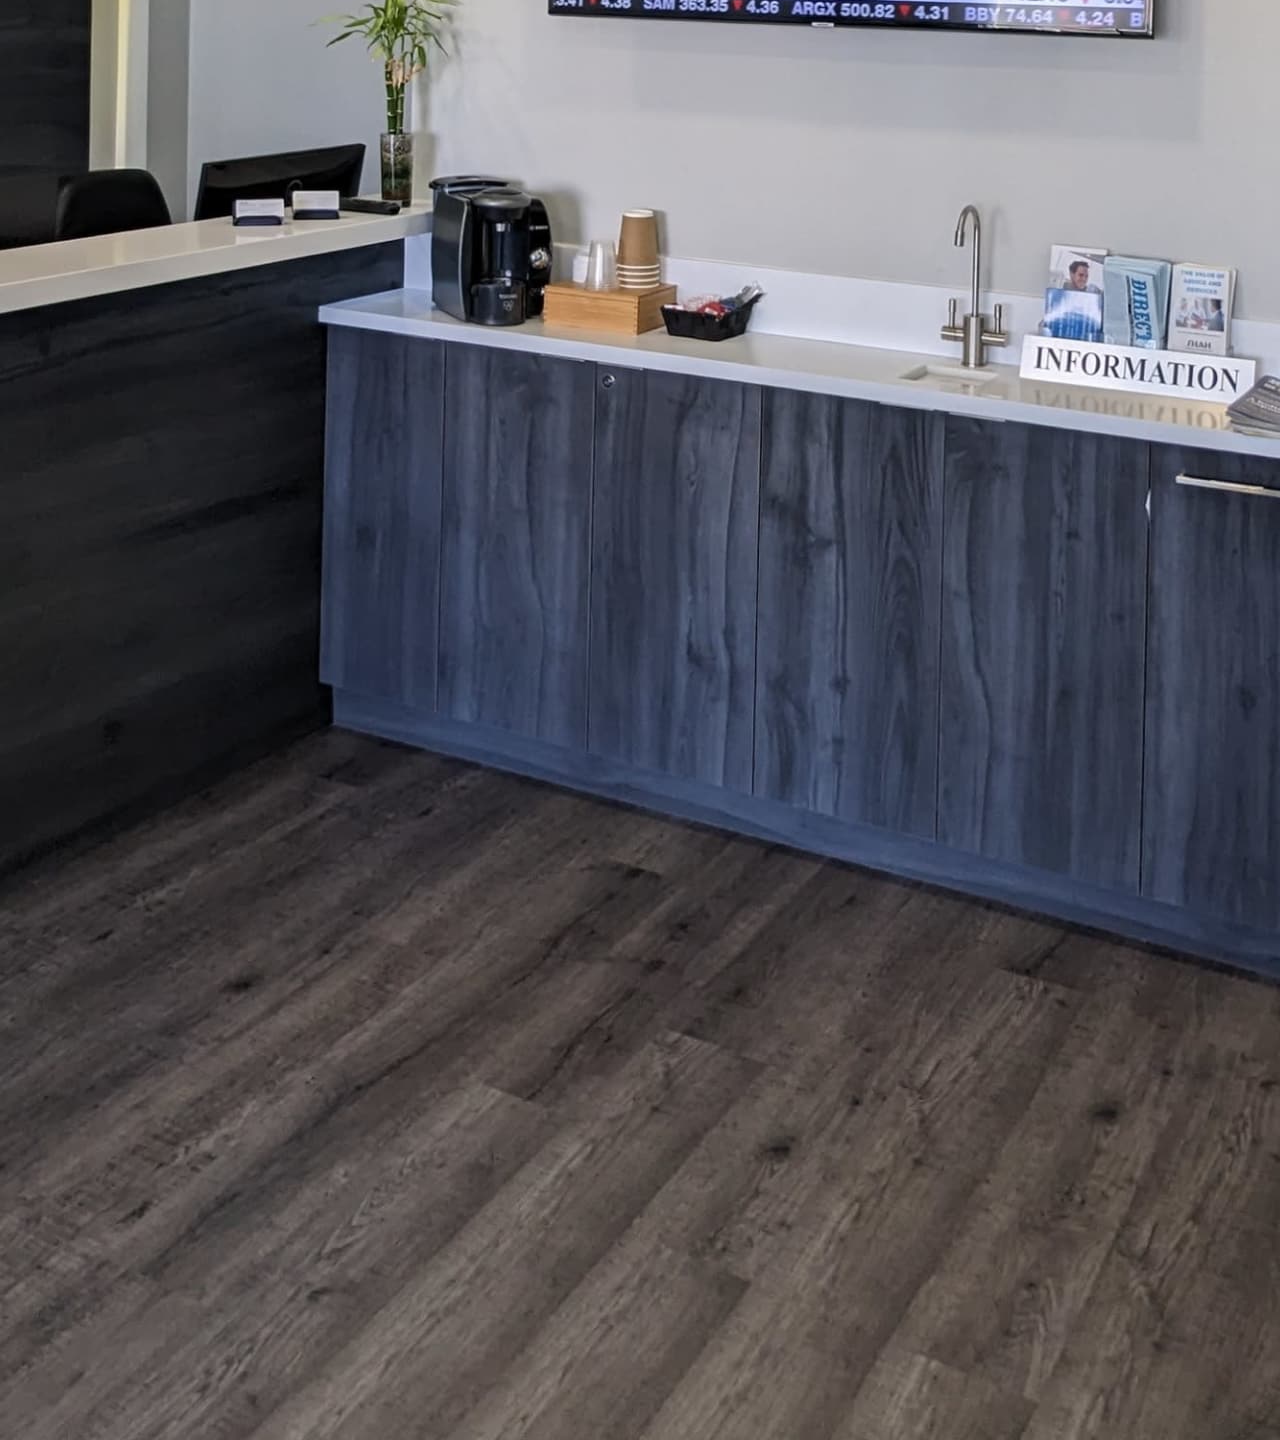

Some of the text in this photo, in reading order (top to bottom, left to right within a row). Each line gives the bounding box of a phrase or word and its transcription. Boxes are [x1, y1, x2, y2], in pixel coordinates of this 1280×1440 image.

[746, 1, 779, 13] 4.36
[792, 2, 835, 15] ARGX
[840, 4, 894, 18] 500.82
[914, 6, 949, 20] 4.31
[965, 8, 999, 21] BBY
[1006, 10, 1053, 23] 74.64
[1076, 11, 1114, 25] 4.24
[1034, 346, 1240, 393] INFORMATION
